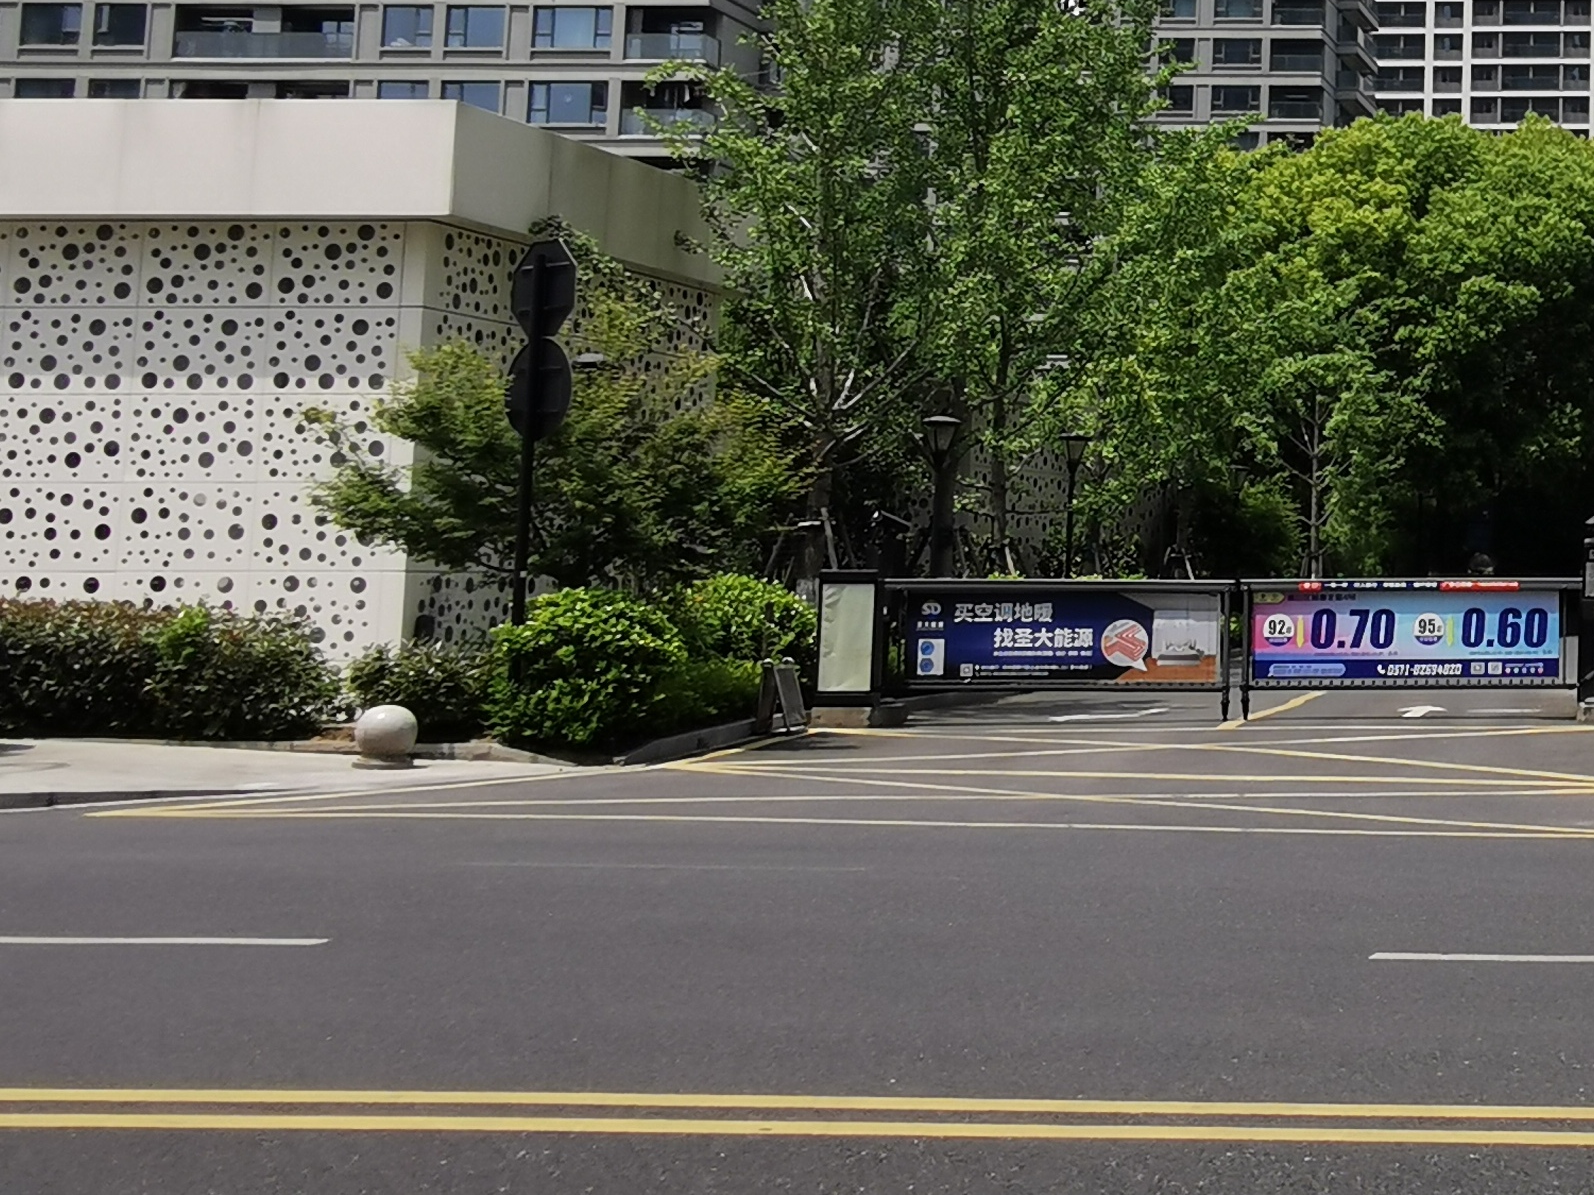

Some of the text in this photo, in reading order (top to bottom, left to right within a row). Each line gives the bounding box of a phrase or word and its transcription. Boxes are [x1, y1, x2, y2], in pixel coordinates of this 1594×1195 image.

[953, 602, 1054, 623] 买空调地暖
[1461, 607, 1549, 649] 0.60
[993, 627, 1094, 648] 找圣大能源
[1310, 608, 1396, 650] 0.70
